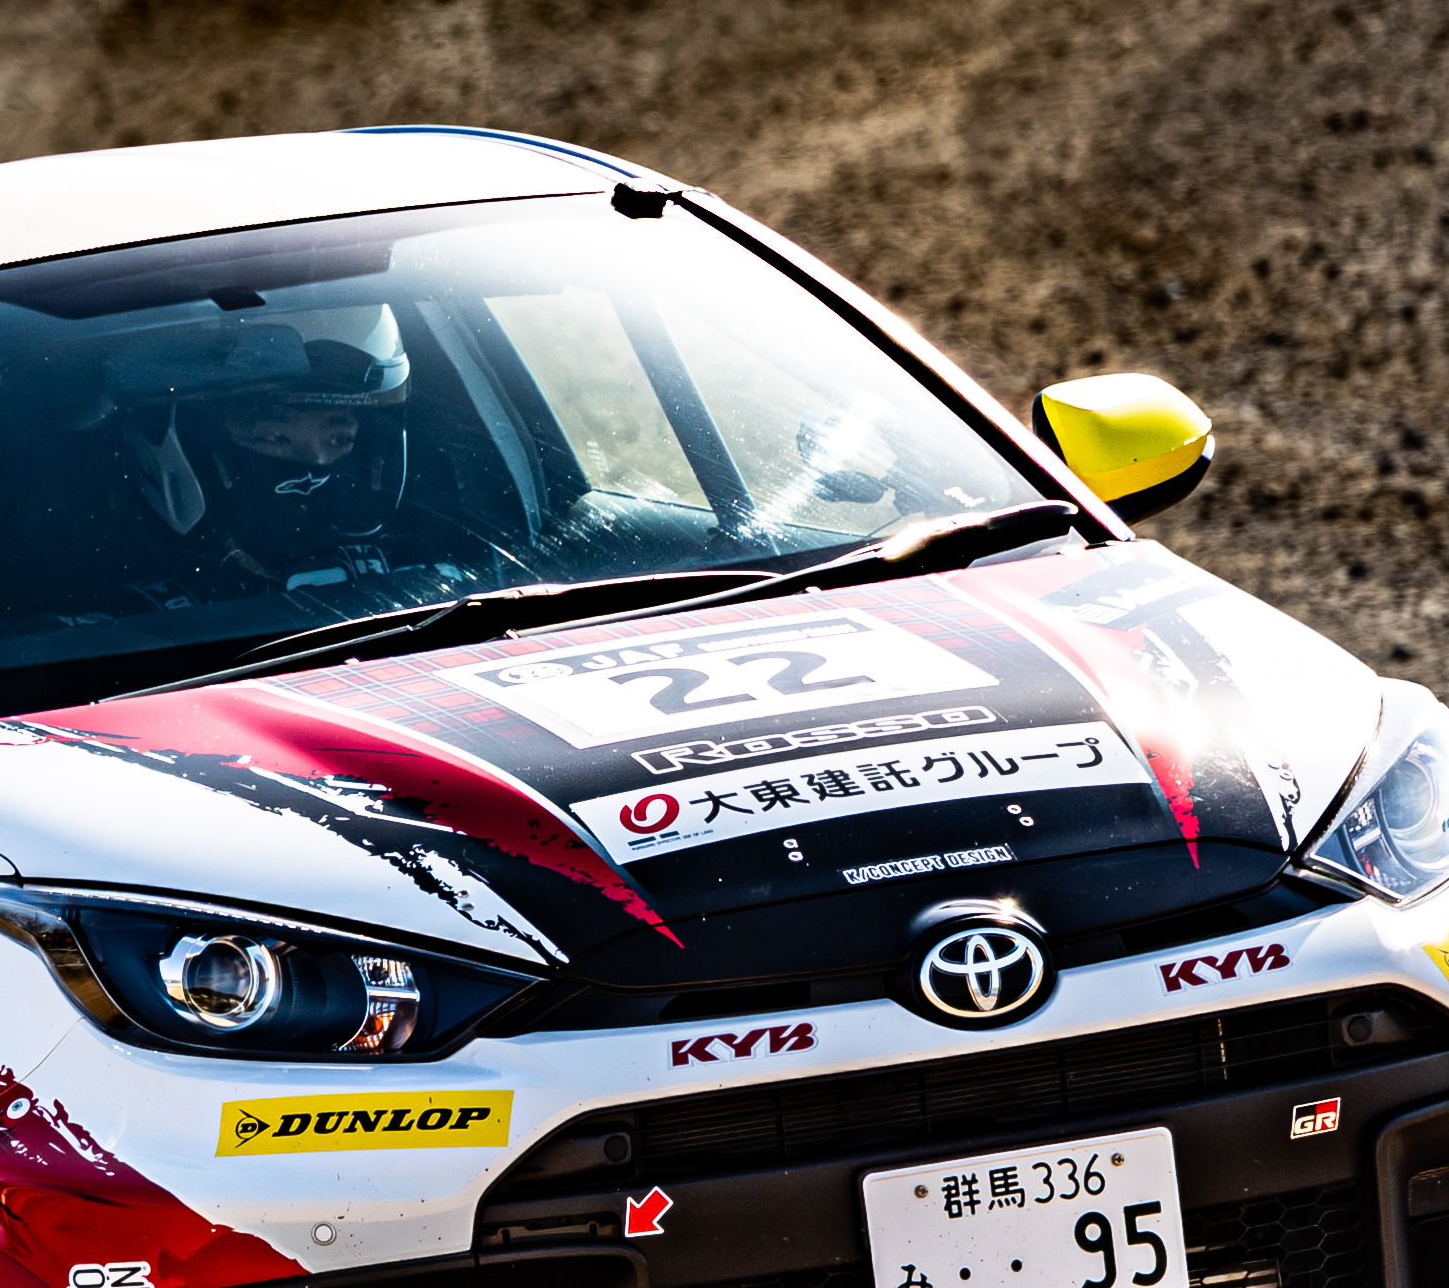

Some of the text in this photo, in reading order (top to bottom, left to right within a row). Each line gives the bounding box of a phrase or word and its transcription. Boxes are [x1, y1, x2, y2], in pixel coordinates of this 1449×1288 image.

[581, 642, 683, 669] JAF
[608, 649, 876, 715] 22
[689, 736, 1104, 825] 大東建託グループ
[843, 845, 1013, 884] K/CONCEPT DESIGN
[1160, 943, 1291, 993] KYB
[672, 1022, 817, 1068] KYB
[272, 1107, 491, 1139] DUNLOP
[1293, 1110, 1338, 1136] GR
[941, 1153, 1106, 1219] 群馬 336
